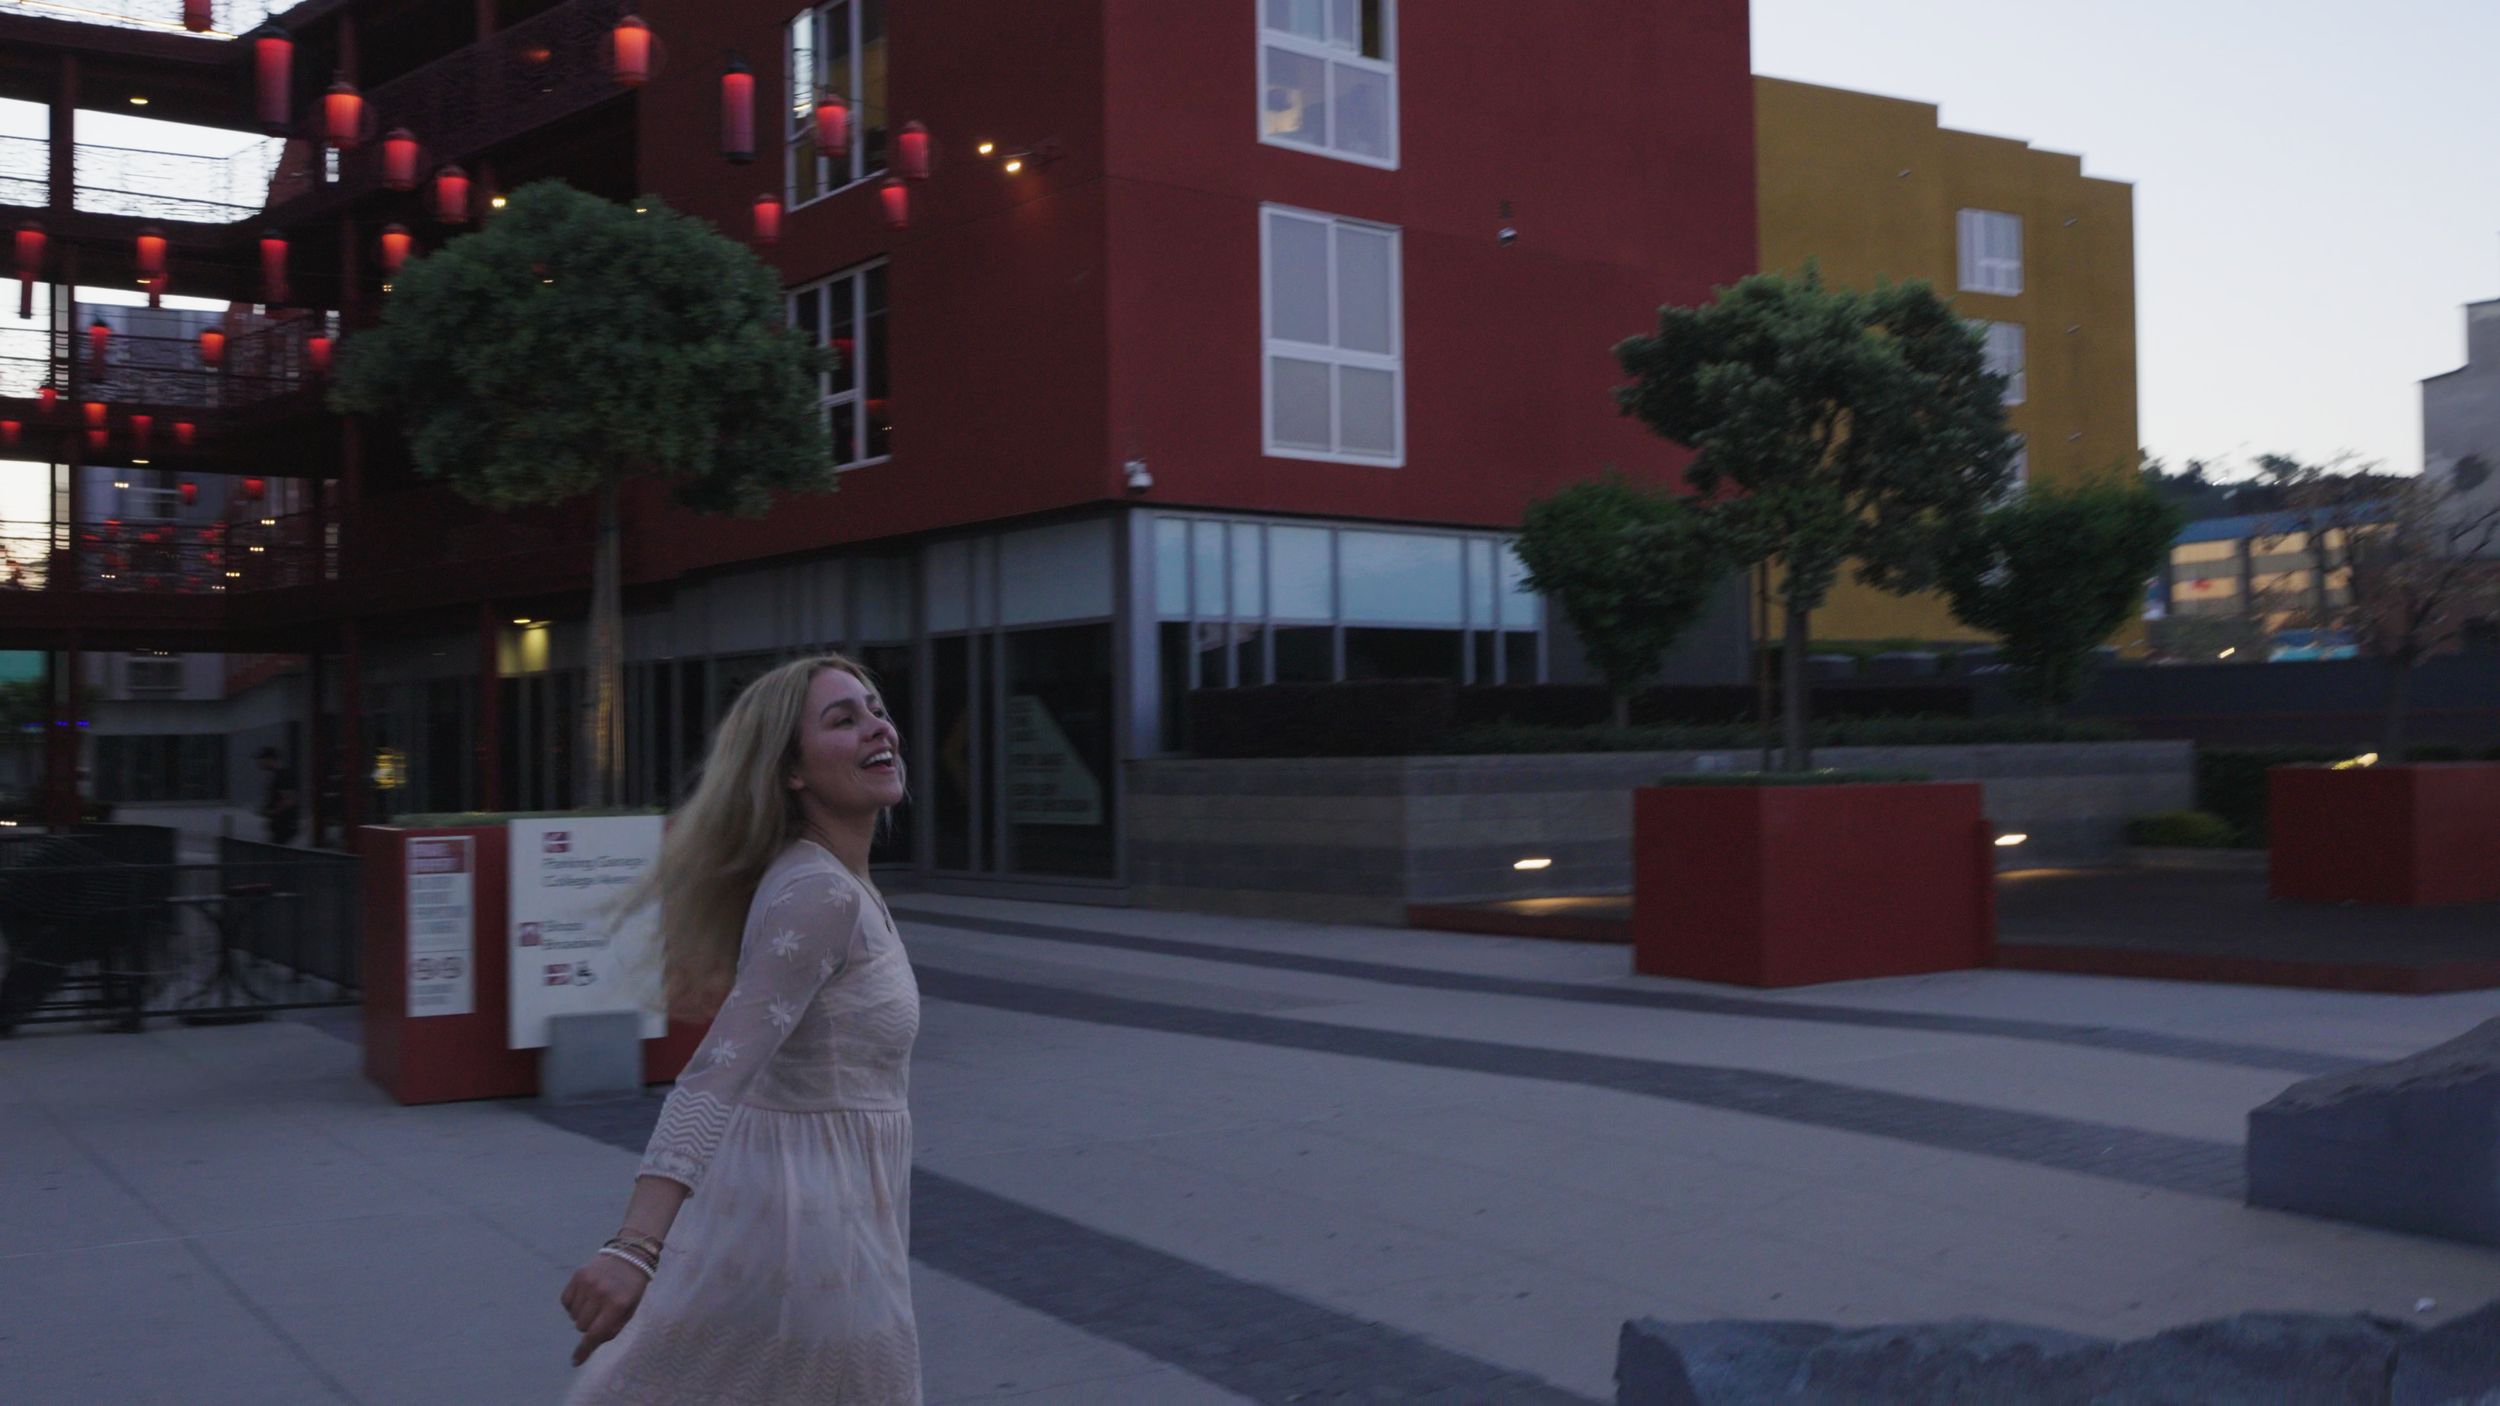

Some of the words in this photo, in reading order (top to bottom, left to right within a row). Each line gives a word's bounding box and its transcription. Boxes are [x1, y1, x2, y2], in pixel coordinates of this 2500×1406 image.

[542, 857, 595, 871] Parking
[596, 855, 648, 869] Garage
[542, 875, 596, 889] College
[541, 937, 609, 951] Broadway
